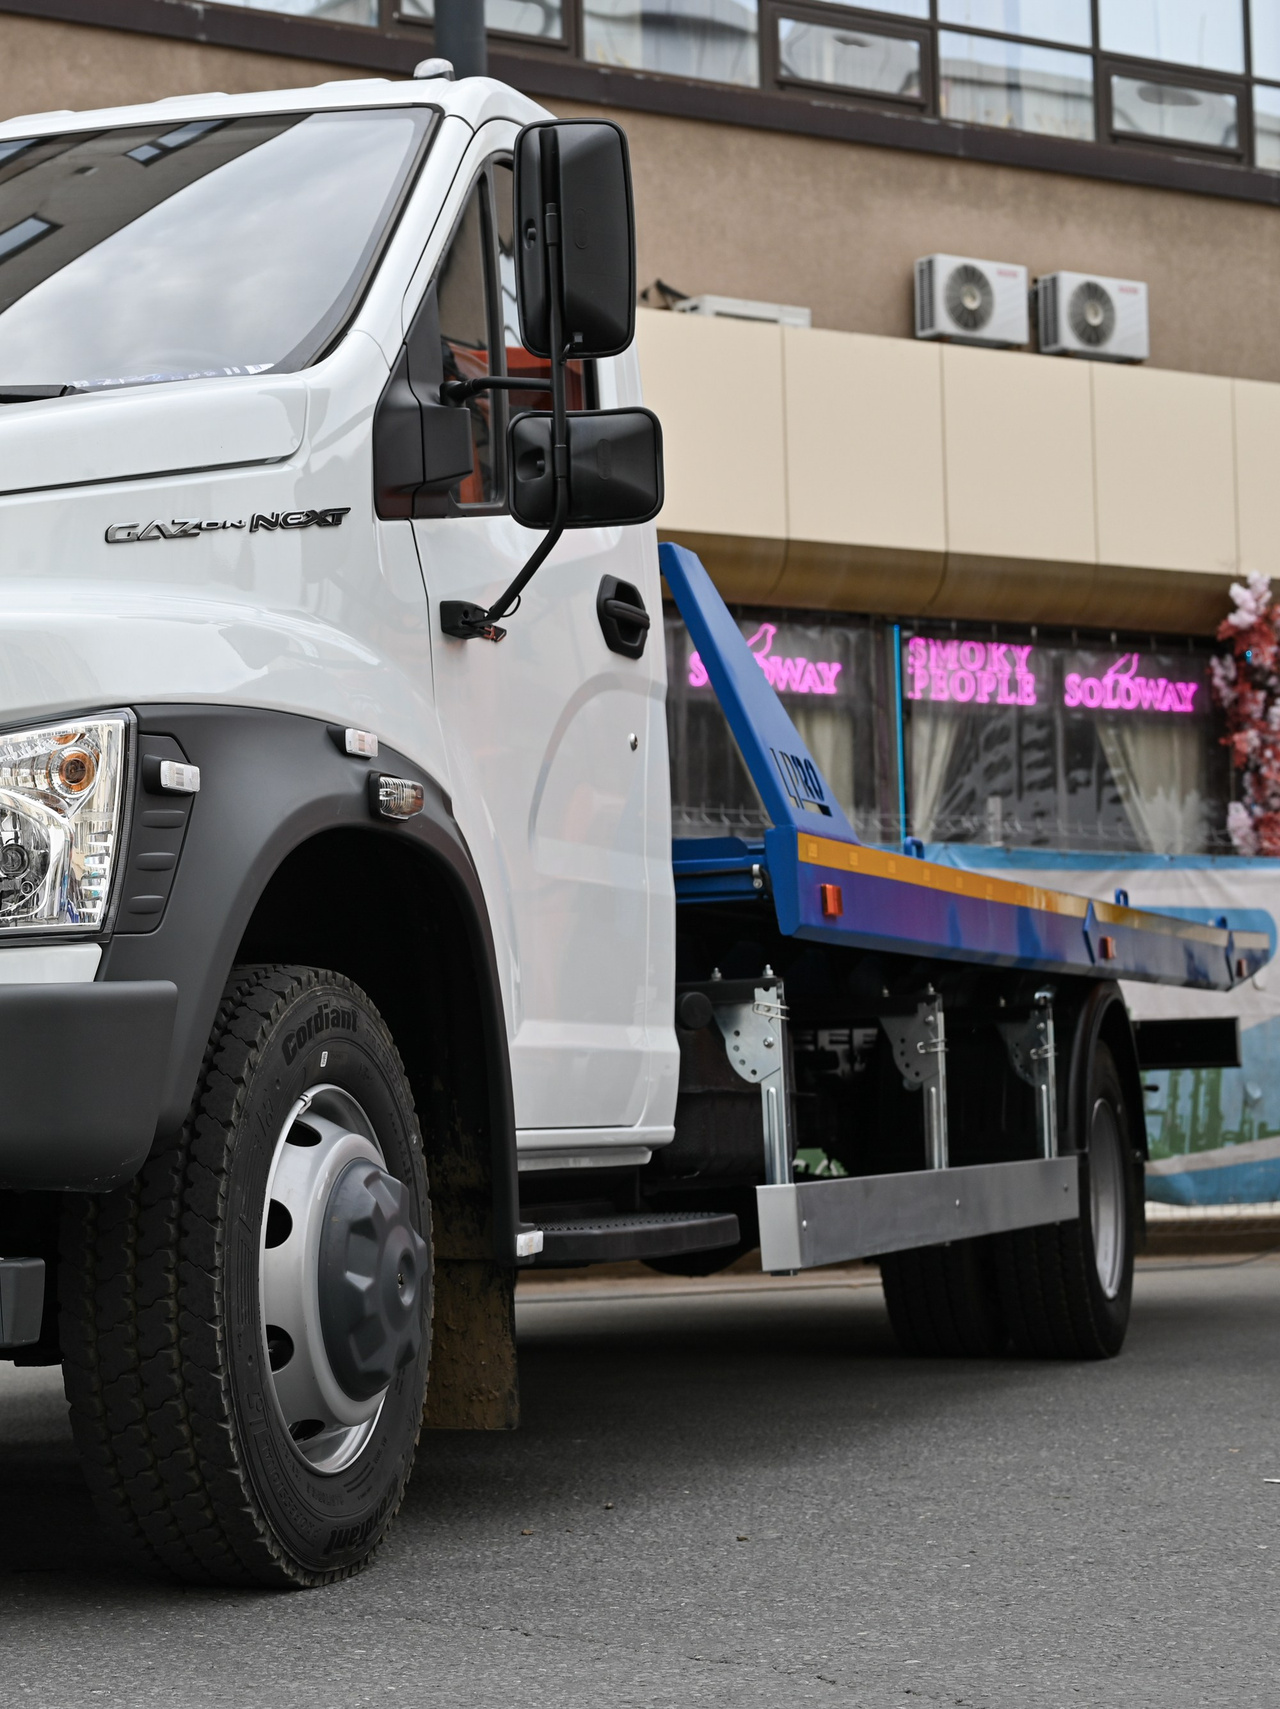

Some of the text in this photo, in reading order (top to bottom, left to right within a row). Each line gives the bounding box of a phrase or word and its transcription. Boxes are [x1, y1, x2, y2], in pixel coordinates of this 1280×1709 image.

[908, 637, 1033, 675] SMOKY
[907, 669, 1037, 706] PEOPLE
[1064, 672, 1198, 712] SOLOWAY
[281, 1002, 359, 1067] Cordiant
